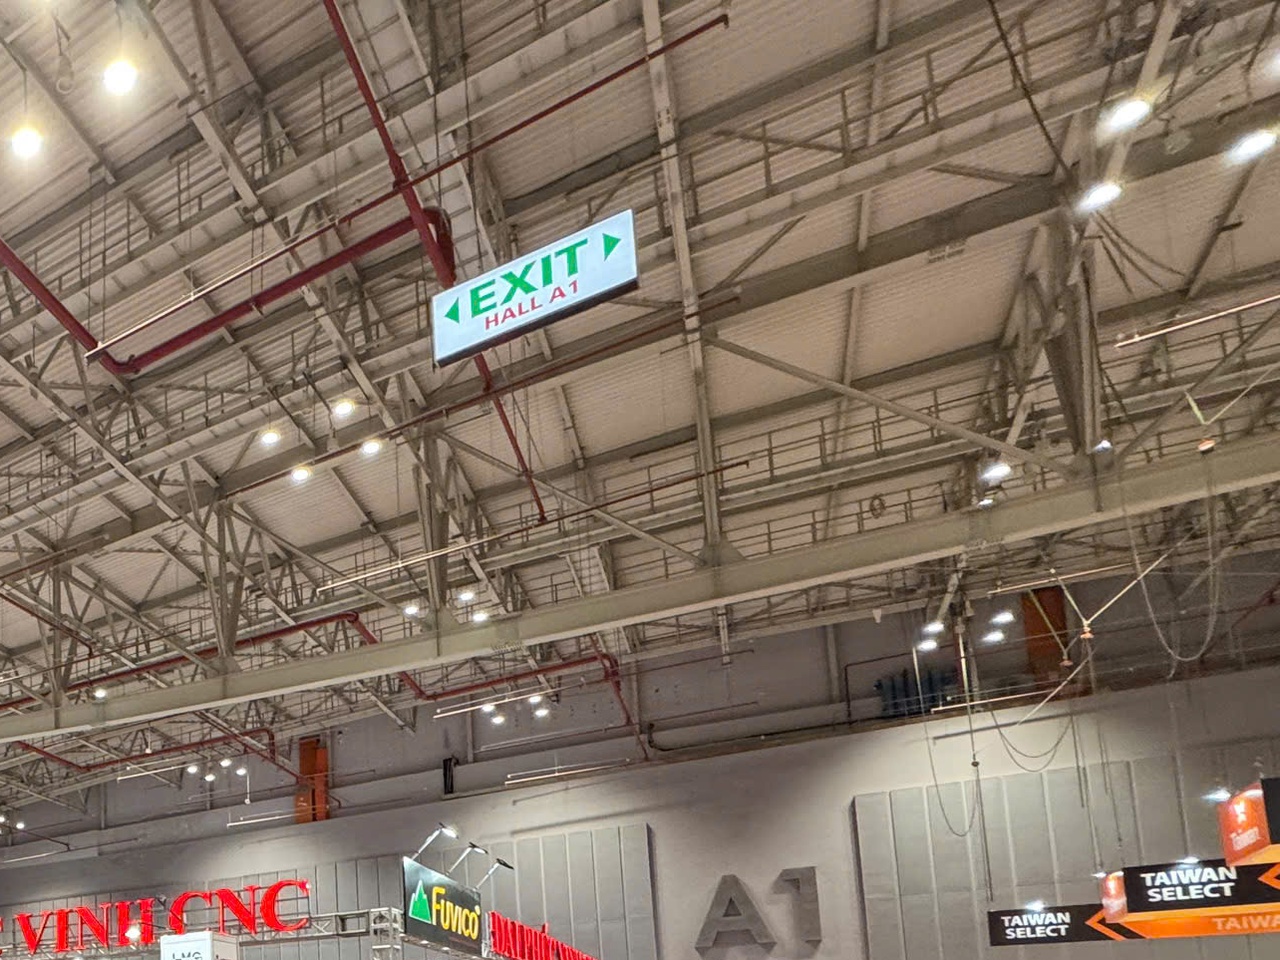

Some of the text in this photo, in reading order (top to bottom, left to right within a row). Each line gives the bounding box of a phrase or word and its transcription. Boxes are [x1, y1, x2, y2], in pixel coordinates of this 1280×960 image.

[470, 238, 588, 318] EXIT
[485, 280, 578, 330] HALL A1
[1140, 867, 1237, 887] TAIWAN
[1147, 882, 1235, 902] SELECT
[16, 897, 157, 955] VINH
[169, 879, 311, 936] CNC
[696, 866, 822, 960] A1
[1001, 912, 1070, 927] TAIWAN
[1005, 925, 1069, 939] SELECT
